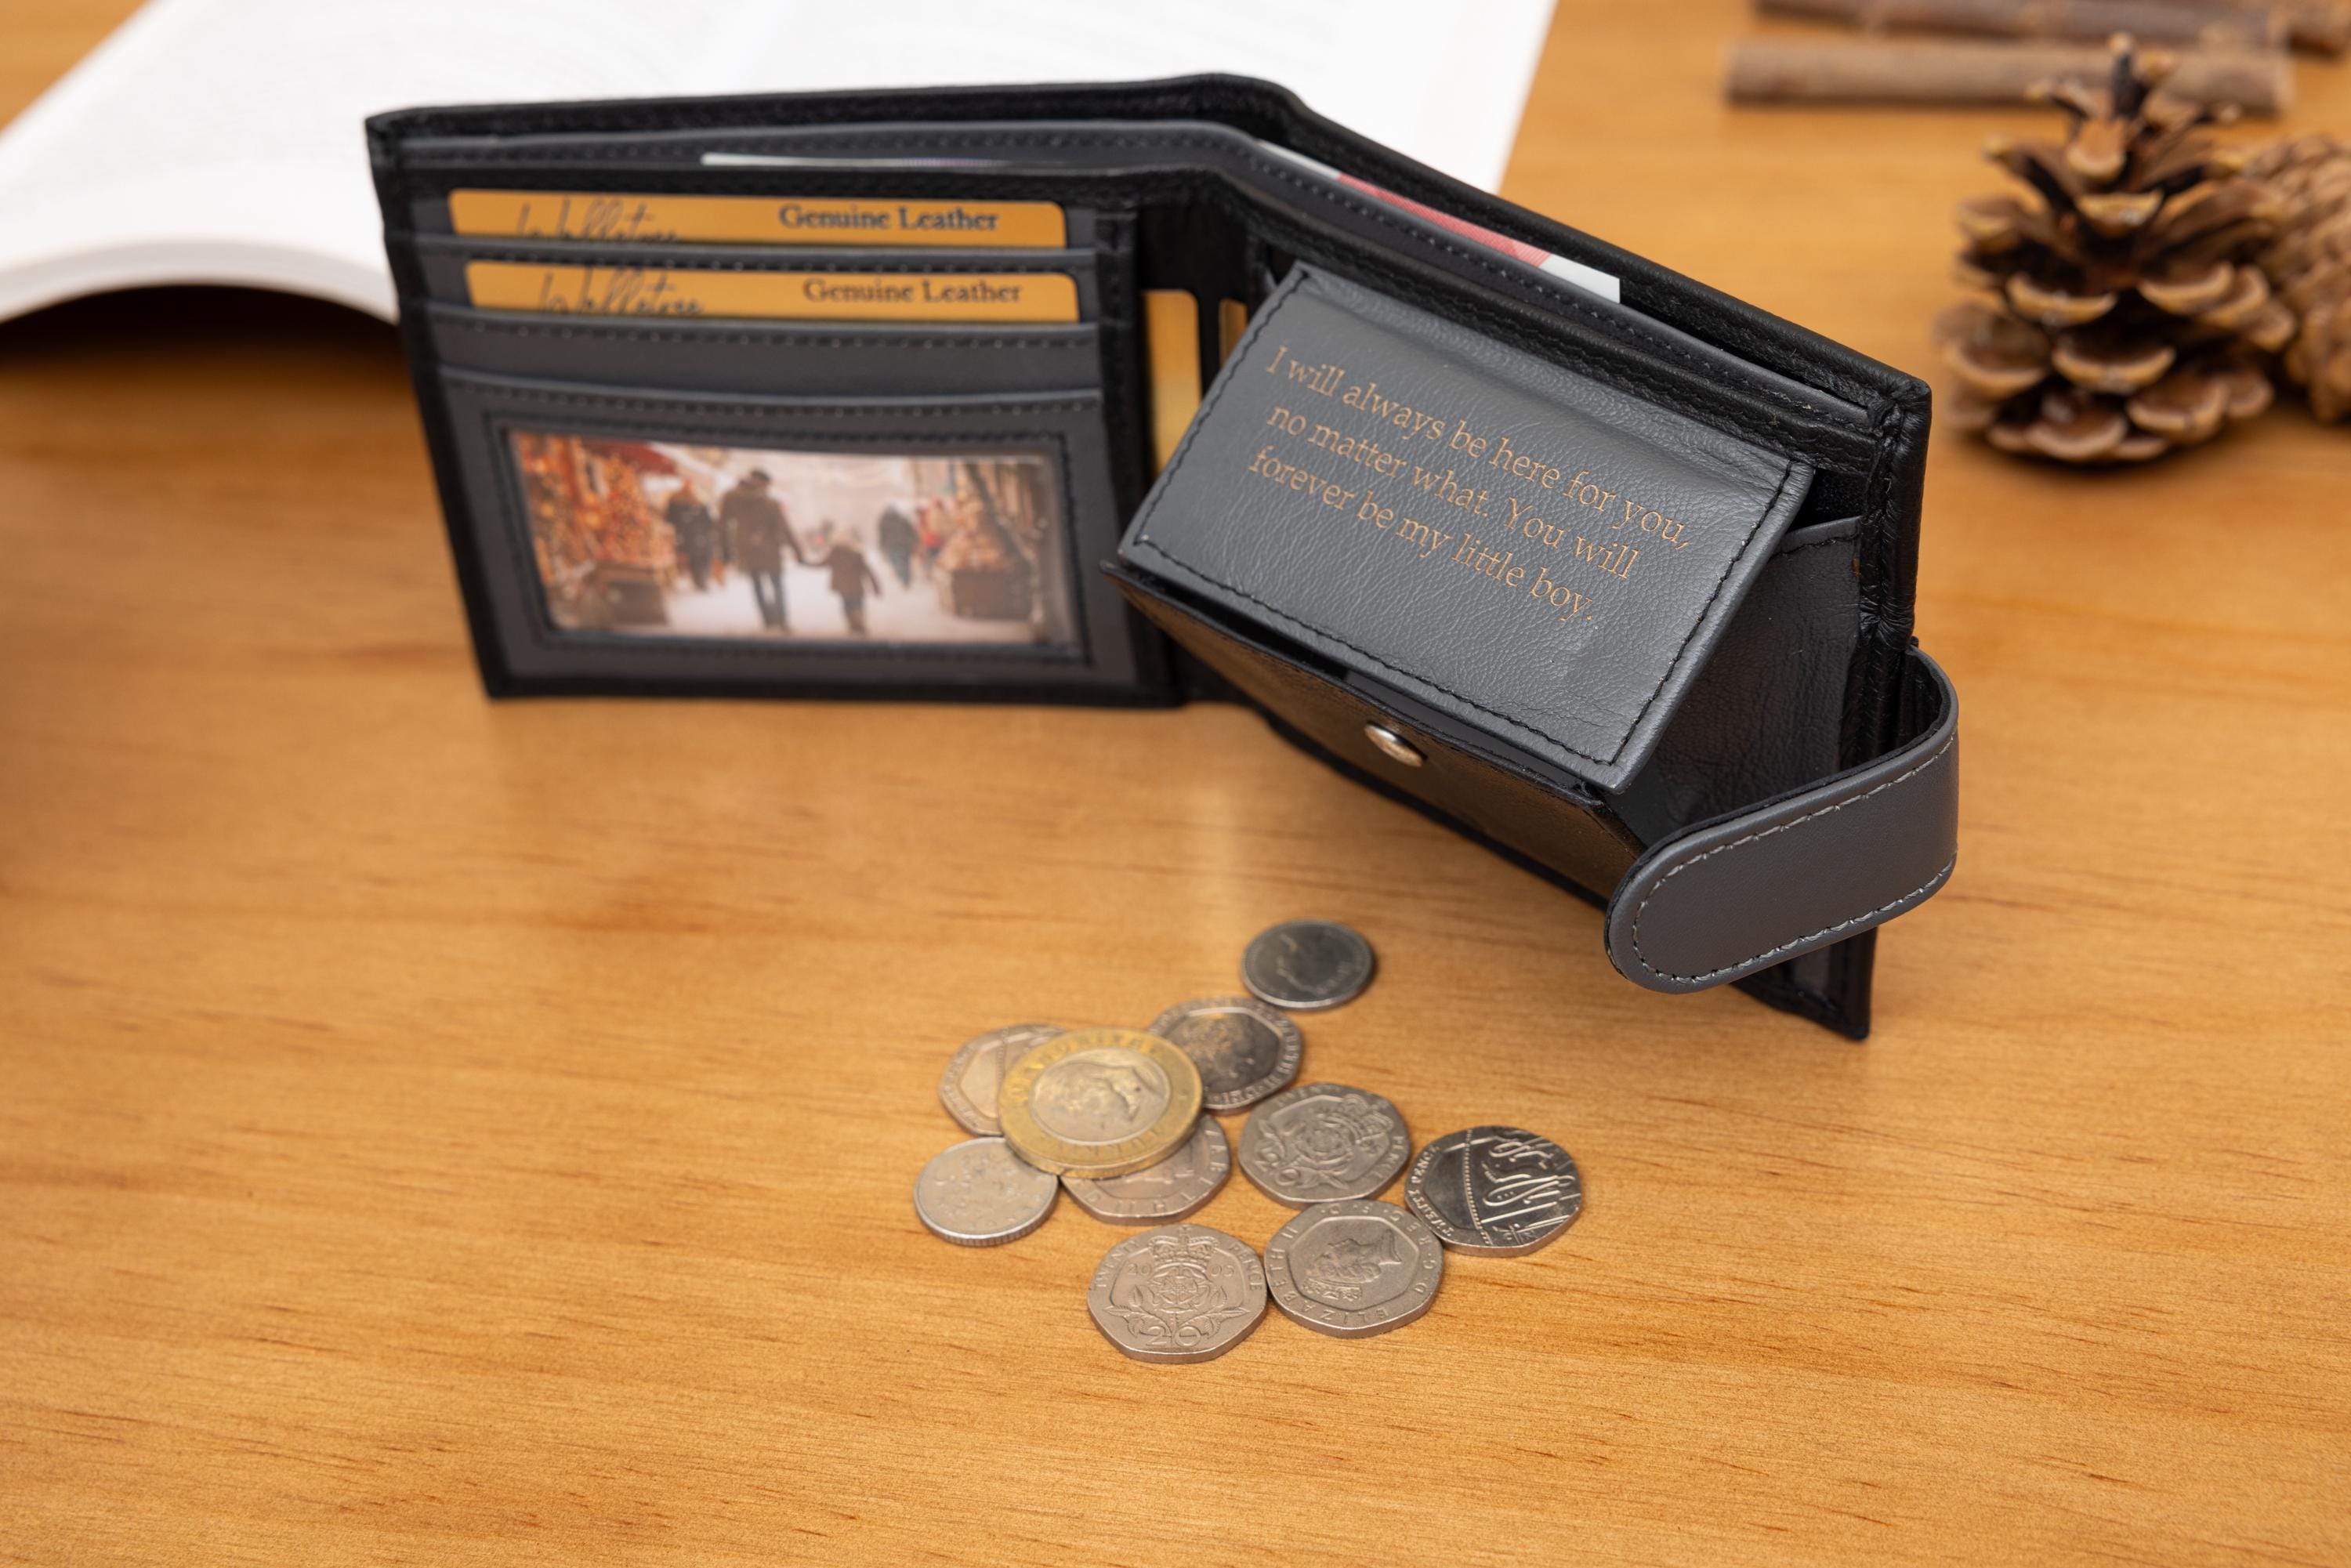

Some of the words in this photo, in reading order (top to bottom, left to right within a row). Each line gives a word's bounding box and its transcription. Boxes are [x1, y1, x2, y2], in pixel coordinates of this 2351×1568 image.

[778, 203, 891, 230] Genuine
[898, 206, 999, 232] Leather
[802, 278, 916, 303] Genuine
[921, 280, 1023, 303] Leather
[1266, 346, 1288, 374] I
[1288, 360, 1344, 396] will
[1342, 382, 1447, 440] always
[1449, 418, 1487, 458] be
[1489, 436, 1561, 490] here
[1563, 470, 1617, 512] for
[1610, 499, 1690, 550] you,
[1267, 406, 1307, 435] no
[1308, 423, 1408, 478] matter
[1412, 468, 1490, 518] what.
[1505, 497, 1566, 549] You
[1574, 534, 1641, 581] will
[1248, 444, 1357, 511] forever
[1355, 489, 1395, 529] be
[1395, 516, 1451, 559] my
[1451, 532, 1526, 588] little
[1528, 566, 1594, 623] boy.
[1096, 1239, 1139, 1288] TWENTY
[1229, 1242, 1263, 1292] PENCE
[1145, 1325, 1202, 1348] 20
